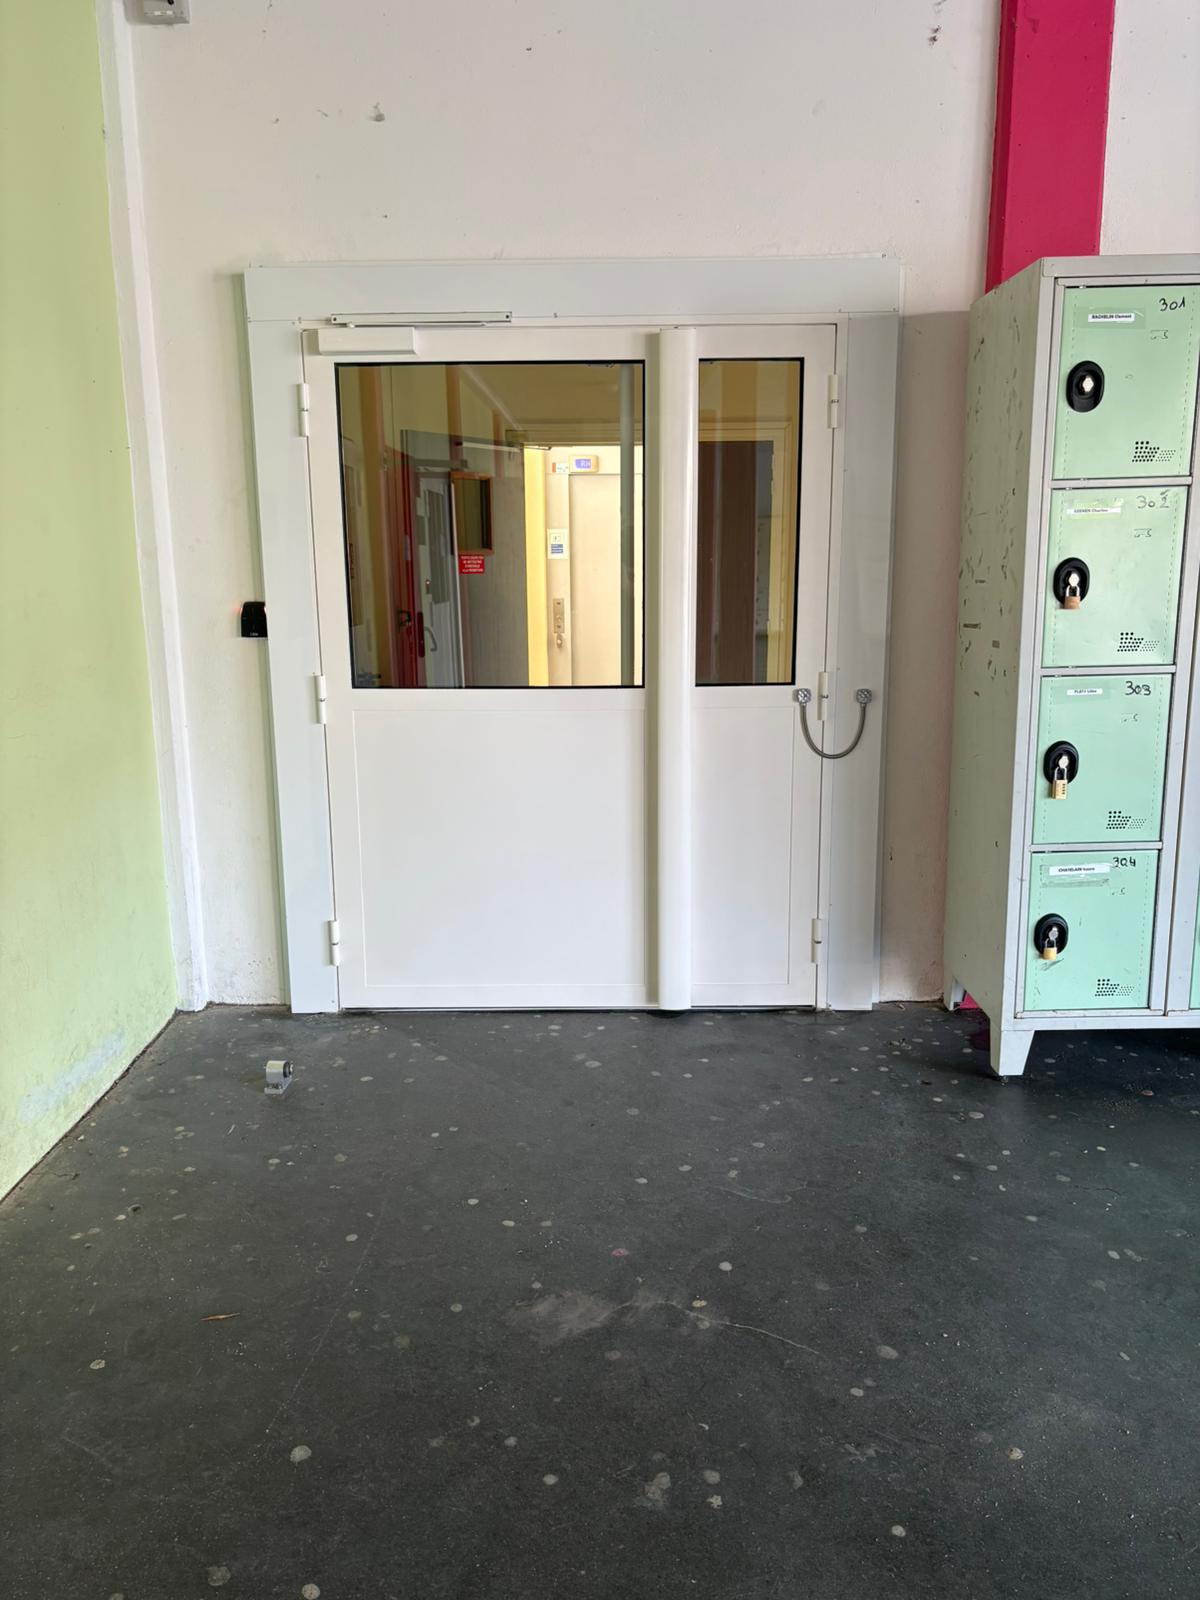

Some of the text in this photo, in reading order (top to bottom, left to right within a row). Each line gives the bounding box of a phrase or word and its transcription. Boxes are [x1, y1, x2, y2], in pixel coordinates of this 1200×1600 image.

[1159, 296, 1186, 312] 301
[1136, 494, 1169, 509] 302
[1125, 680, 1152, 696] 303
[1112, 856, 1136, 869] 304
